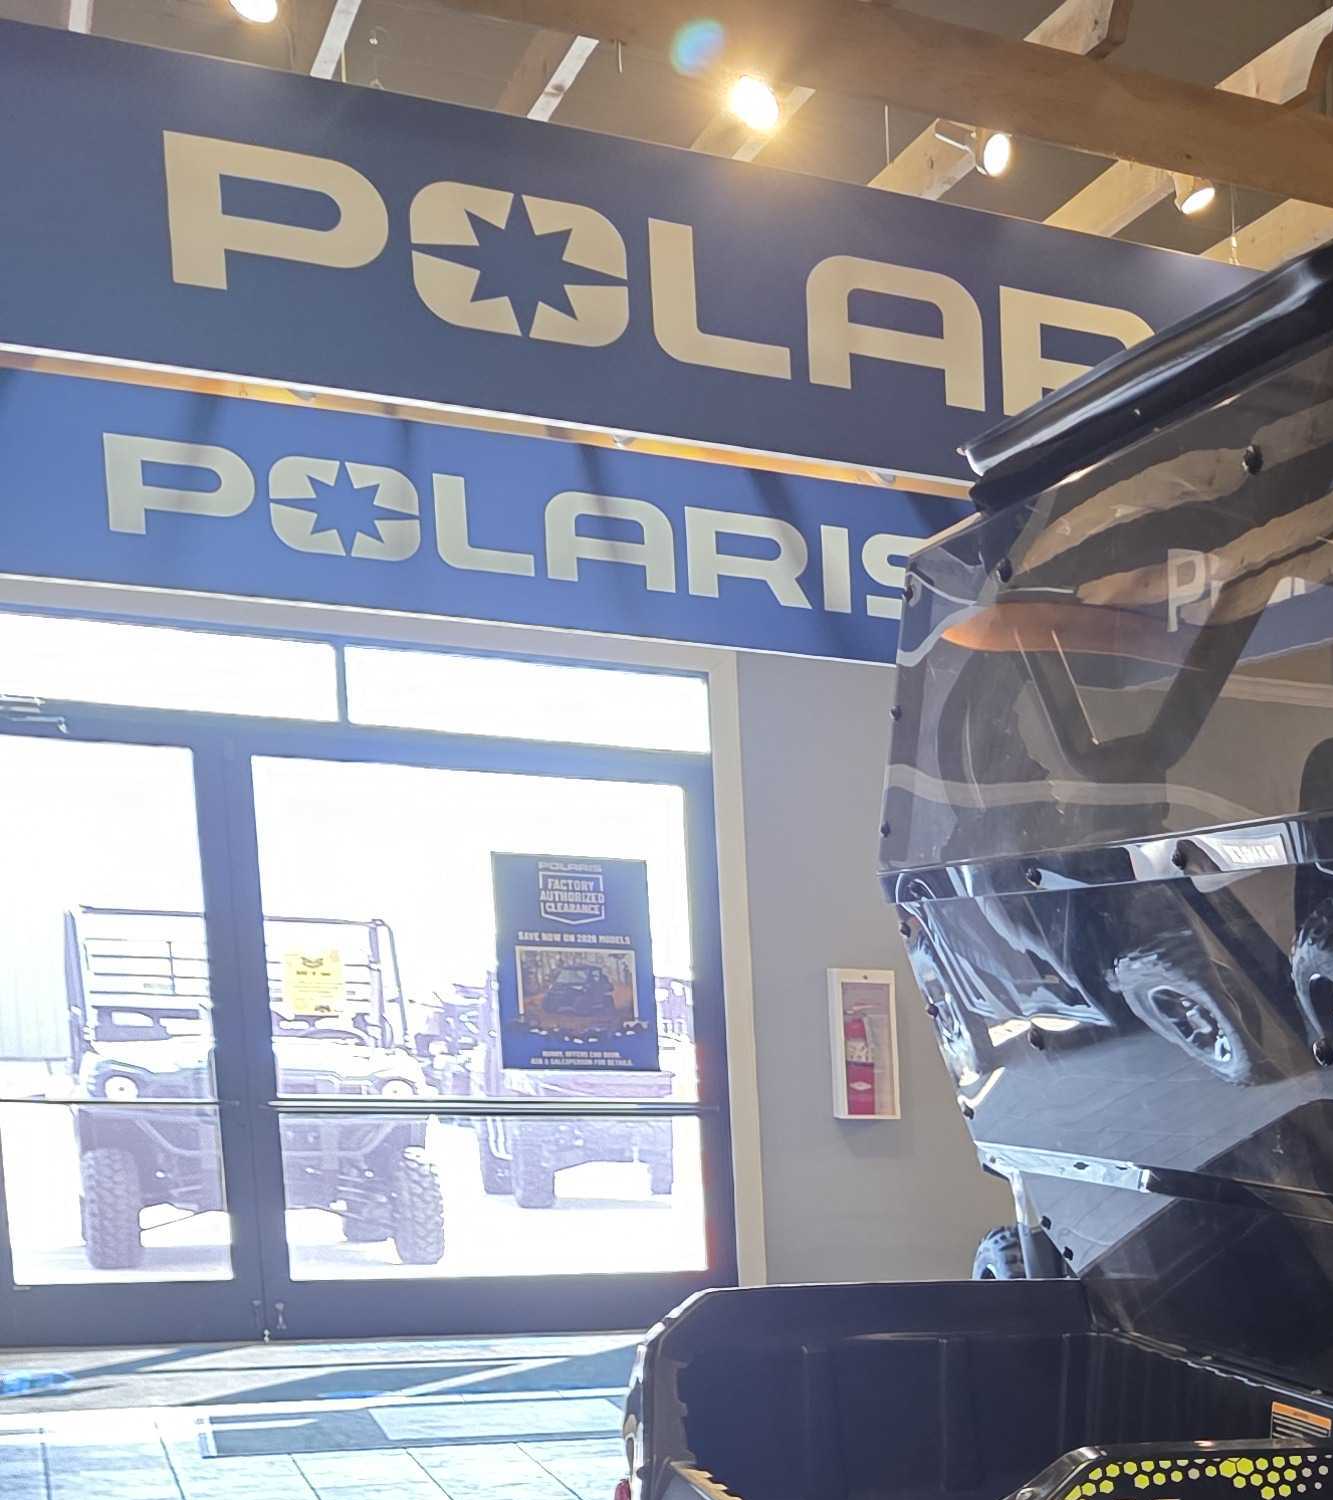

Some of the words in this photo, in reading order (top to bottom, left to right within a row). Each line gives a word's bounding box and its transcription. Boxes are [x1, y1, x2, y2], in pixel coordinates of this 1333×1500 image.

[162, 130, 1156, 415] POLAR
[547, 878, 594, 891] FACTORY
[540, 890, 605, 903] AUTHORIZED
[545, 902, 601, 914] CLEARANCE
